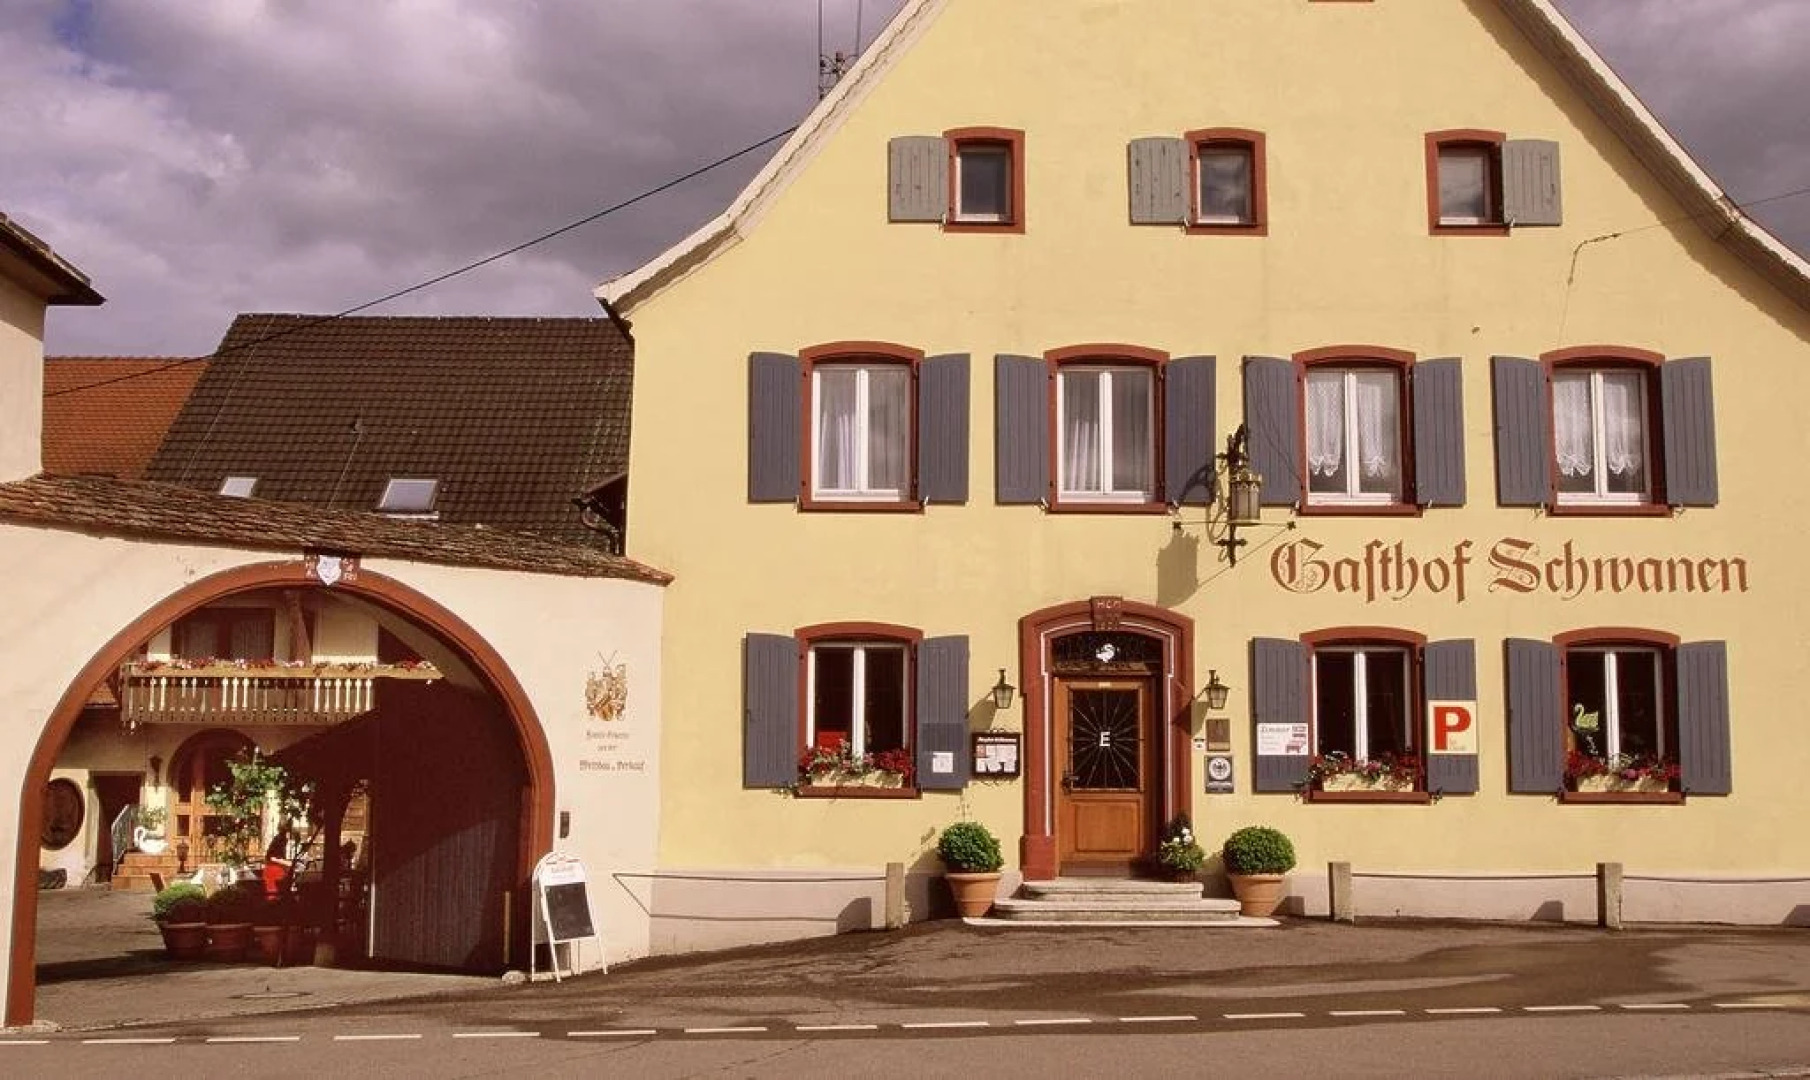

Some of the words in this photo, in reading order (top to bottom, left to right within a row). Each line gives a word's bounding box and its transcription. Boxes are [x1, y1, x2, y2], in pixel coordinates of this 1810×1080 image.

[1487, 537, 1749, 601] Schwanen
[1099, 731, 1110, 747] E
[1433, 705, 1471, 750] P
